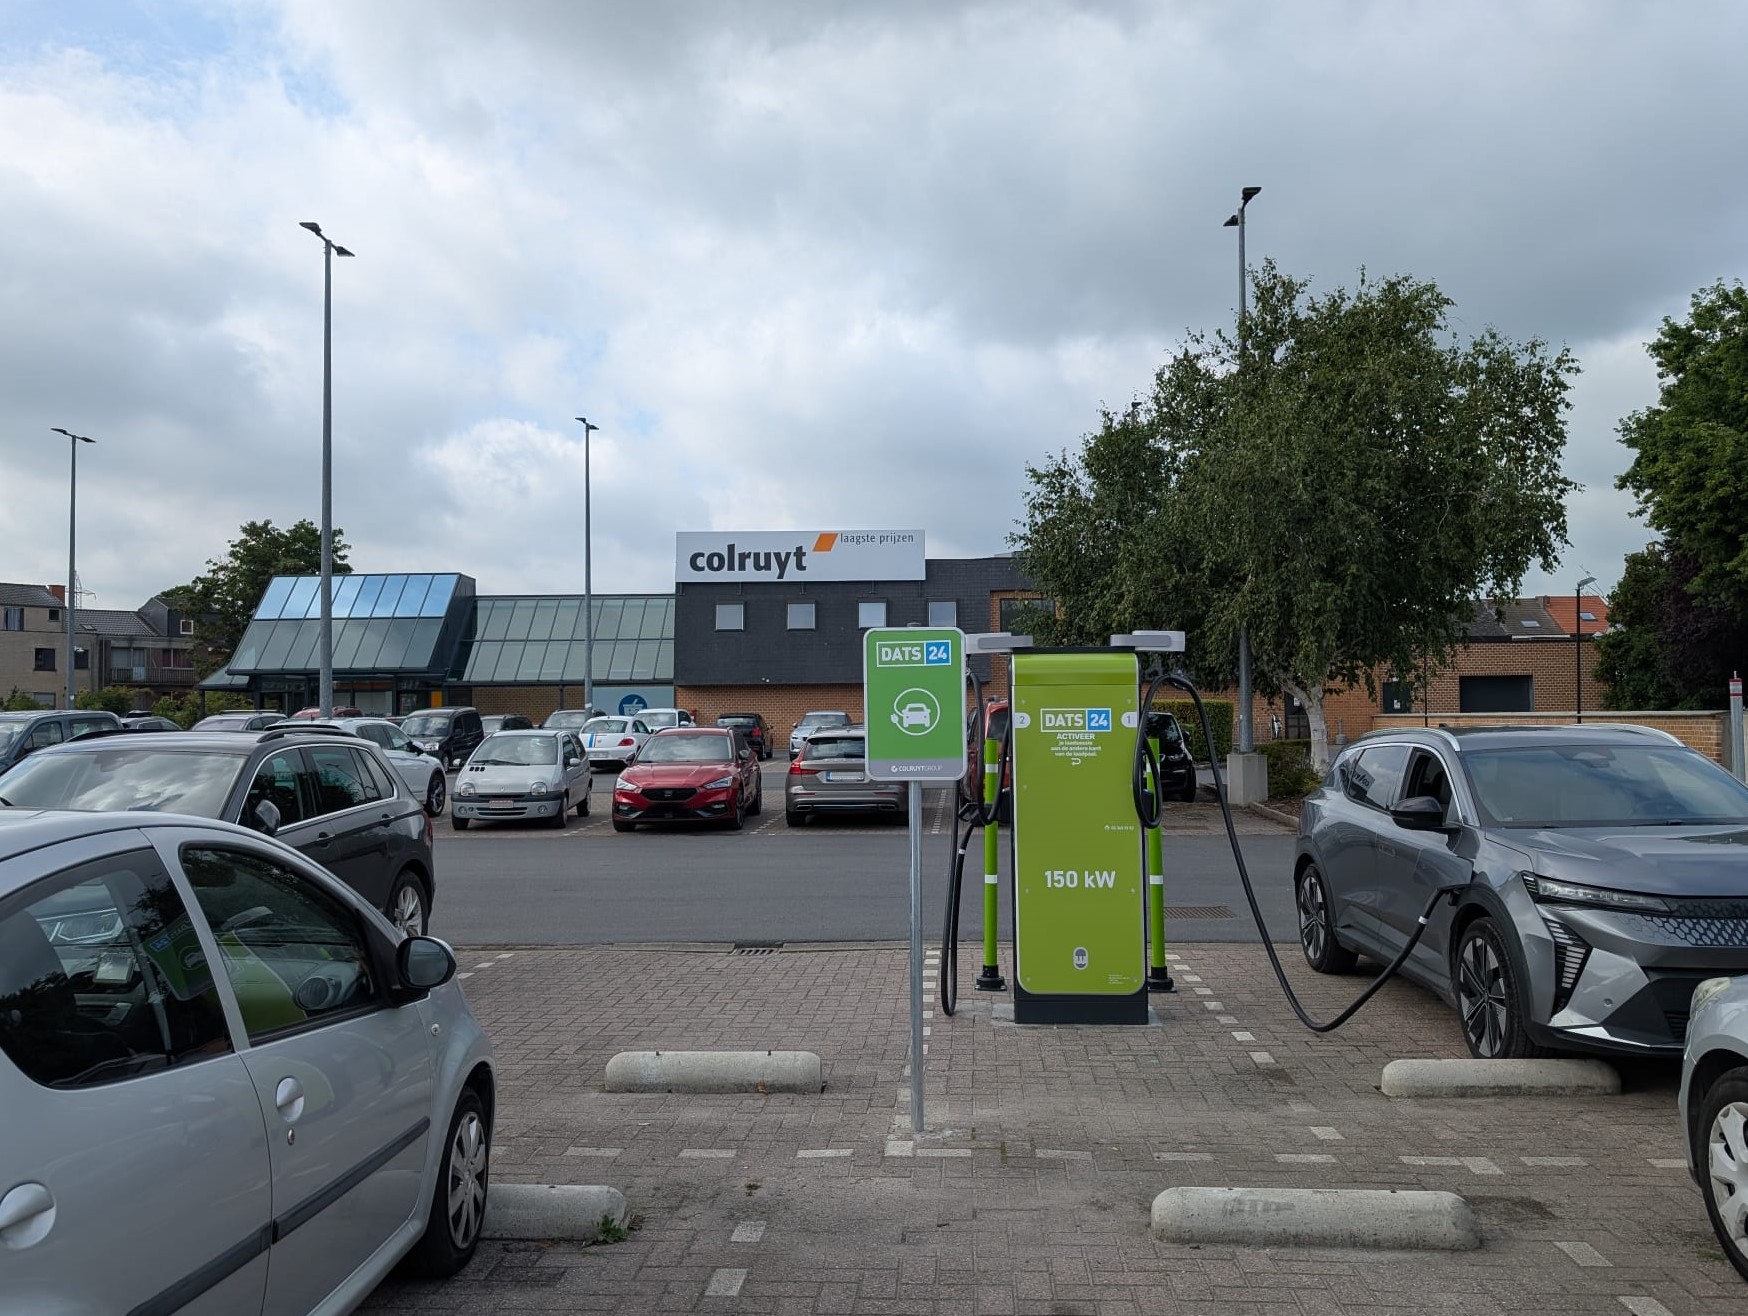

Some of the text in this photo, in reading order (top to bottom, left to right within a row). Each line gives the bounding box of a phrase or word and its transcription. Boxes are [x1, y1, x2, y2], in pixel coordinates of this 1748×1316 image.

[839, 532, 914, 545] laagste prijzen
[689, 543, 807, 580] colruyt
[881, 645, 948, 661] DATS 24
[1045, 713, 1109, 727] DATS 24
[1044, 869, 1116, 889] 150 kW
